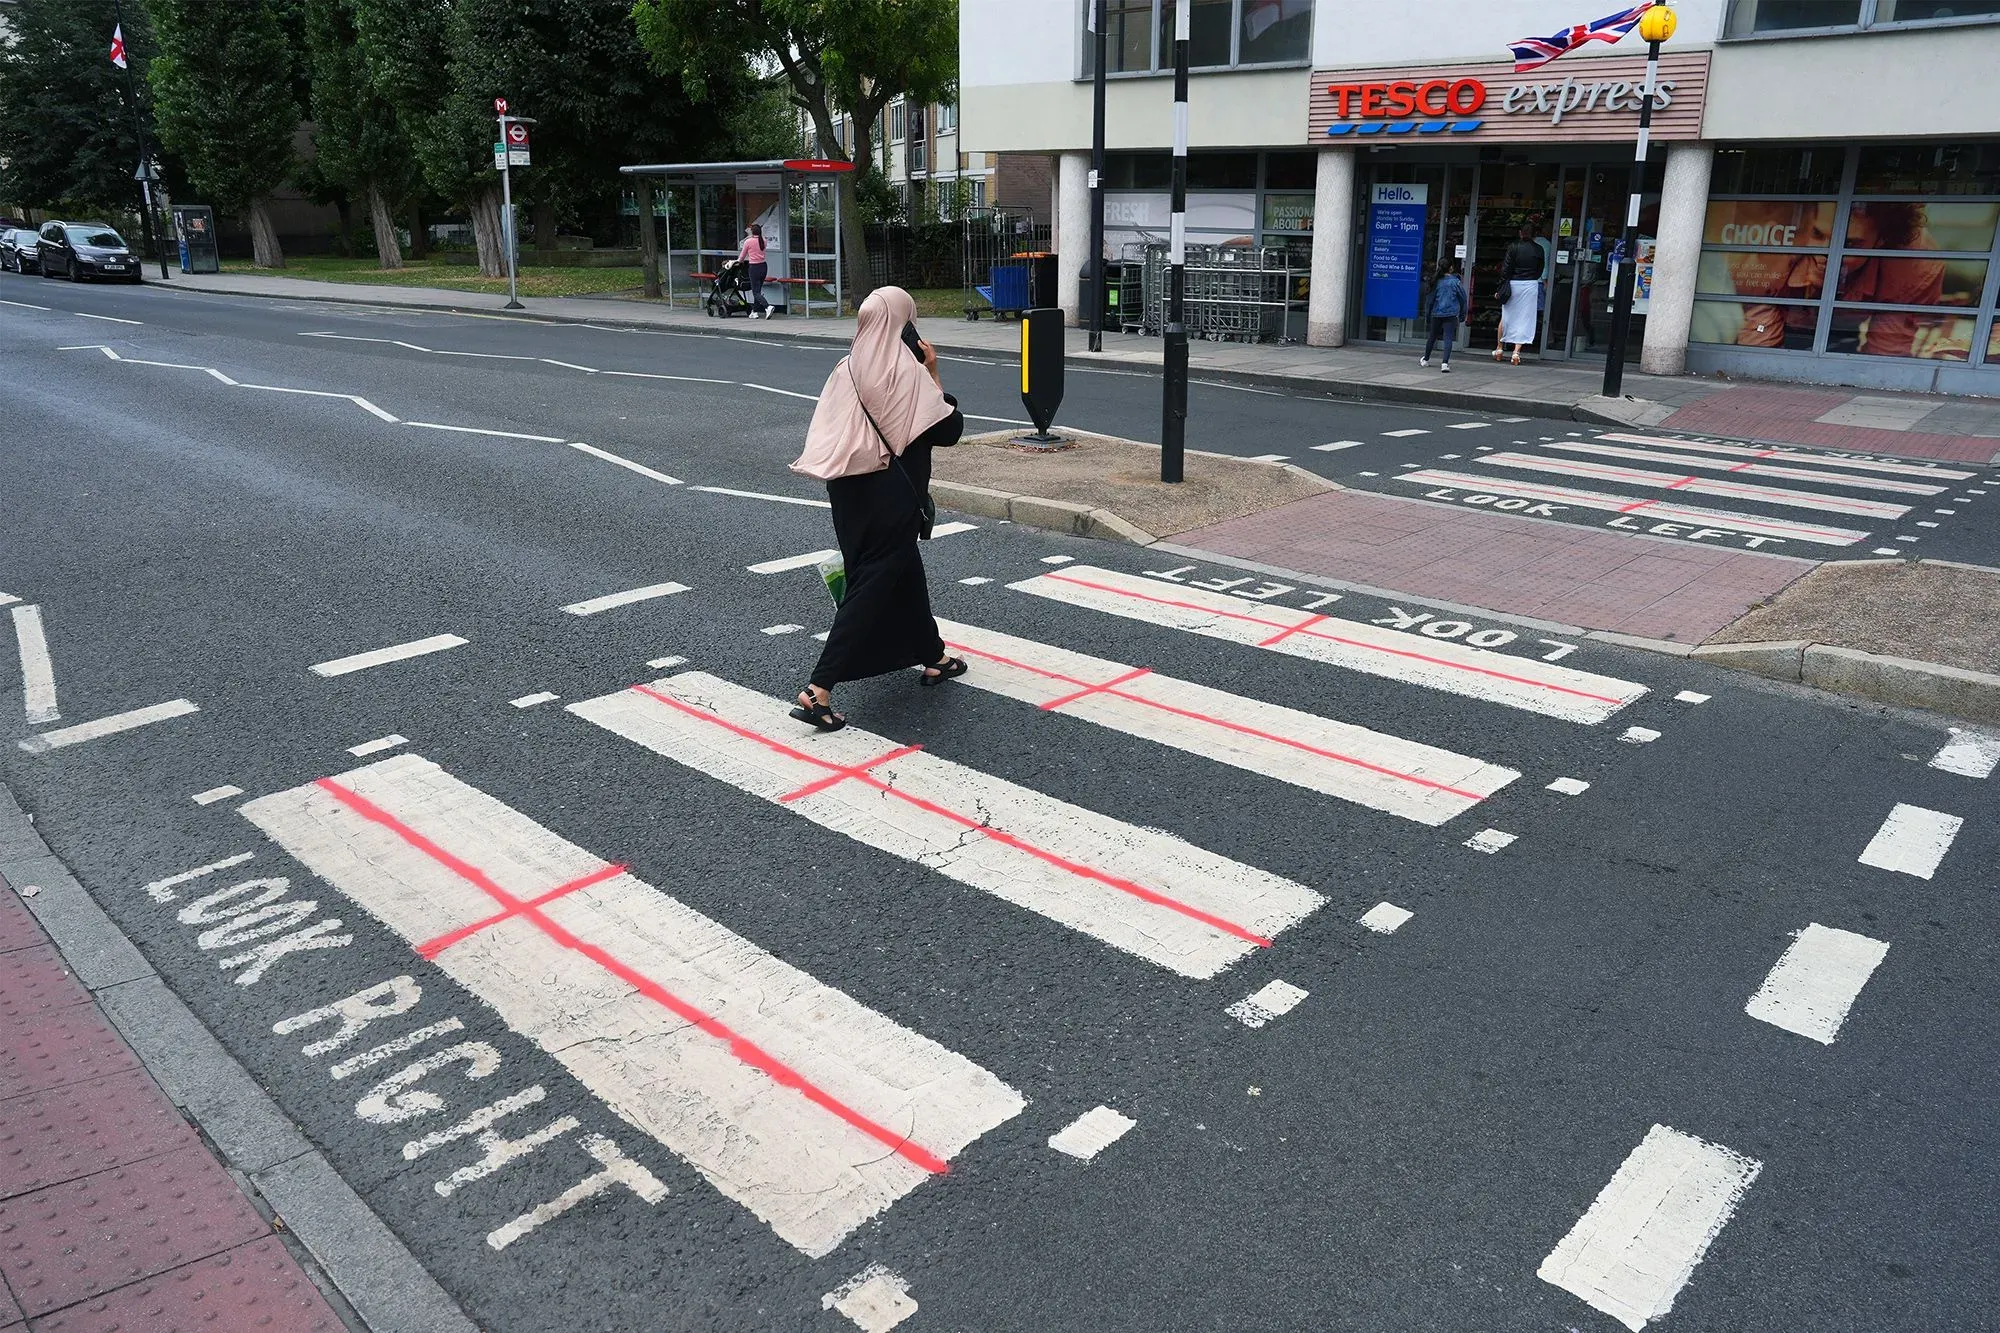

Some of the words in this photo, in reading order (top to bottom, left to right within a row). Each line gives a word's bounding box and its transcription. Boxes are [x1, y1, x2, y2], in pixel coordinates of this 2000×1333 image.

[497, 100, 507, 111] M
[1328, 78, 1486, 118] TESCO
[1502, 76, 1677, 125] express
[1378, 187, 1414, 201] Hello.
[1104, 201, 1149, 222] FRESH
[1272, 219, 1304, 230] ABOUT
[1375, 221, 1392, 230] 6am
[1400, 222, 1419, 233] 11pm
[1722, 223, 1797, 246] CHOICE
[1421, 488, 1570, 517] LOOK
[1606, 516, 1787, 549] LEFT
[1142, 565, 1344, 610] LEFT
[1371, 606, 1580, 662] LOOK
[143, 851, 354, 988] LOOK
[272, 975, 670, 1251] RIGHT
